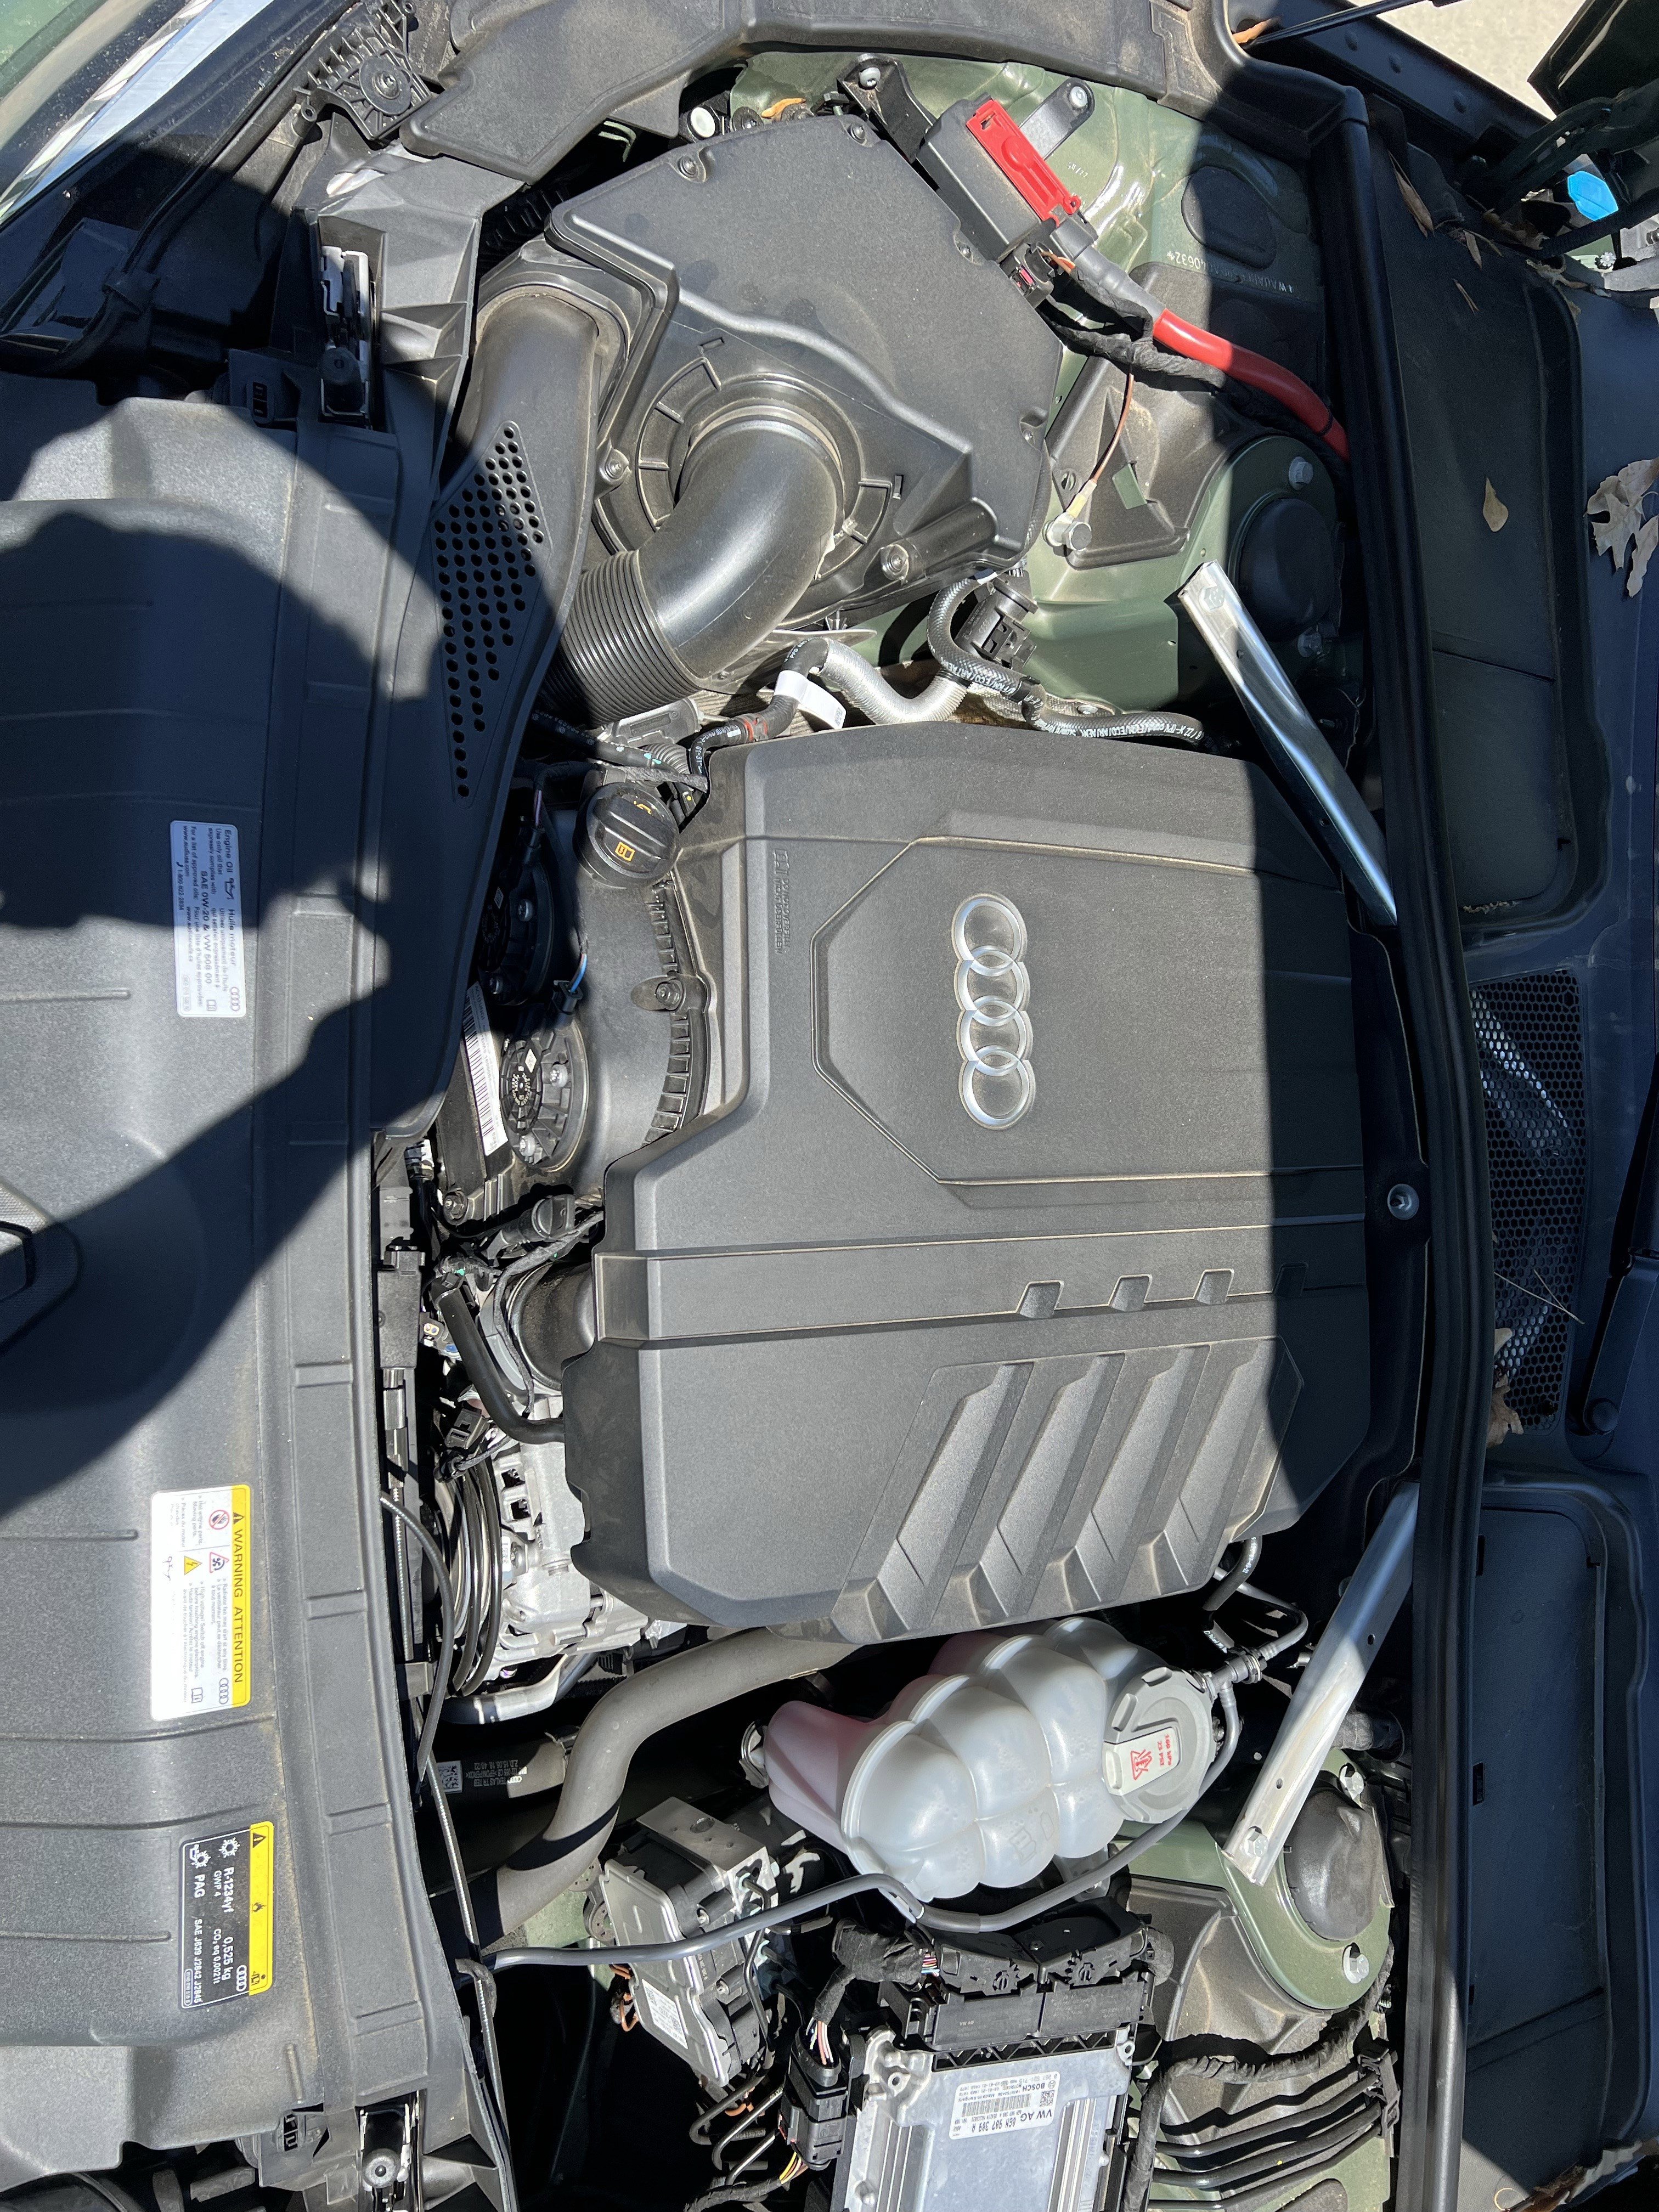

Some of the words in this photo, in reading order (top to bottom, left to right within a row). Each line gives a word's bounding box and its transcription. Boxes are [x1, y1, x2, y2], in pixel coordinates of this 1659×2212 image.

[223, 829, 232, 859] Engine
[225, 861, 233, 872] Oil
[201, 891, 209, 921] 0W-20
[228, 909, 236, 930] Huile
[203, 934, 211, 951] VW
[229, 933, 237, 966] moteur
[205, 973, 212, 984] 00
[233, 1528, 243, 1598] WARNING
[233, 1606, 243, 1684] ATTENTION
[194, 1873, 205, 1899] PAG
[222, 1866, 234, 1915] R-1234yf
[194, 1918, 202, 1936] SAE
[194, 1936, 202, 1956] J639
[212, 1944, 219, 1956] eq
[223, 1936, 233, 1966] 0,525
[222, 1966, 234, 1980] kg
[194, 1979, 203, 2004] J2845
[1022, 2081, 1045, 2092] BOSCH
[1019, 2112, 1034, 2121] AG
[1036, 2108, 1052, 2119] VW
[971, 2123, 975, 2133] A
[978, 2121, 989, 2132] 309
[991, 2119, 1002, 2130] 907
